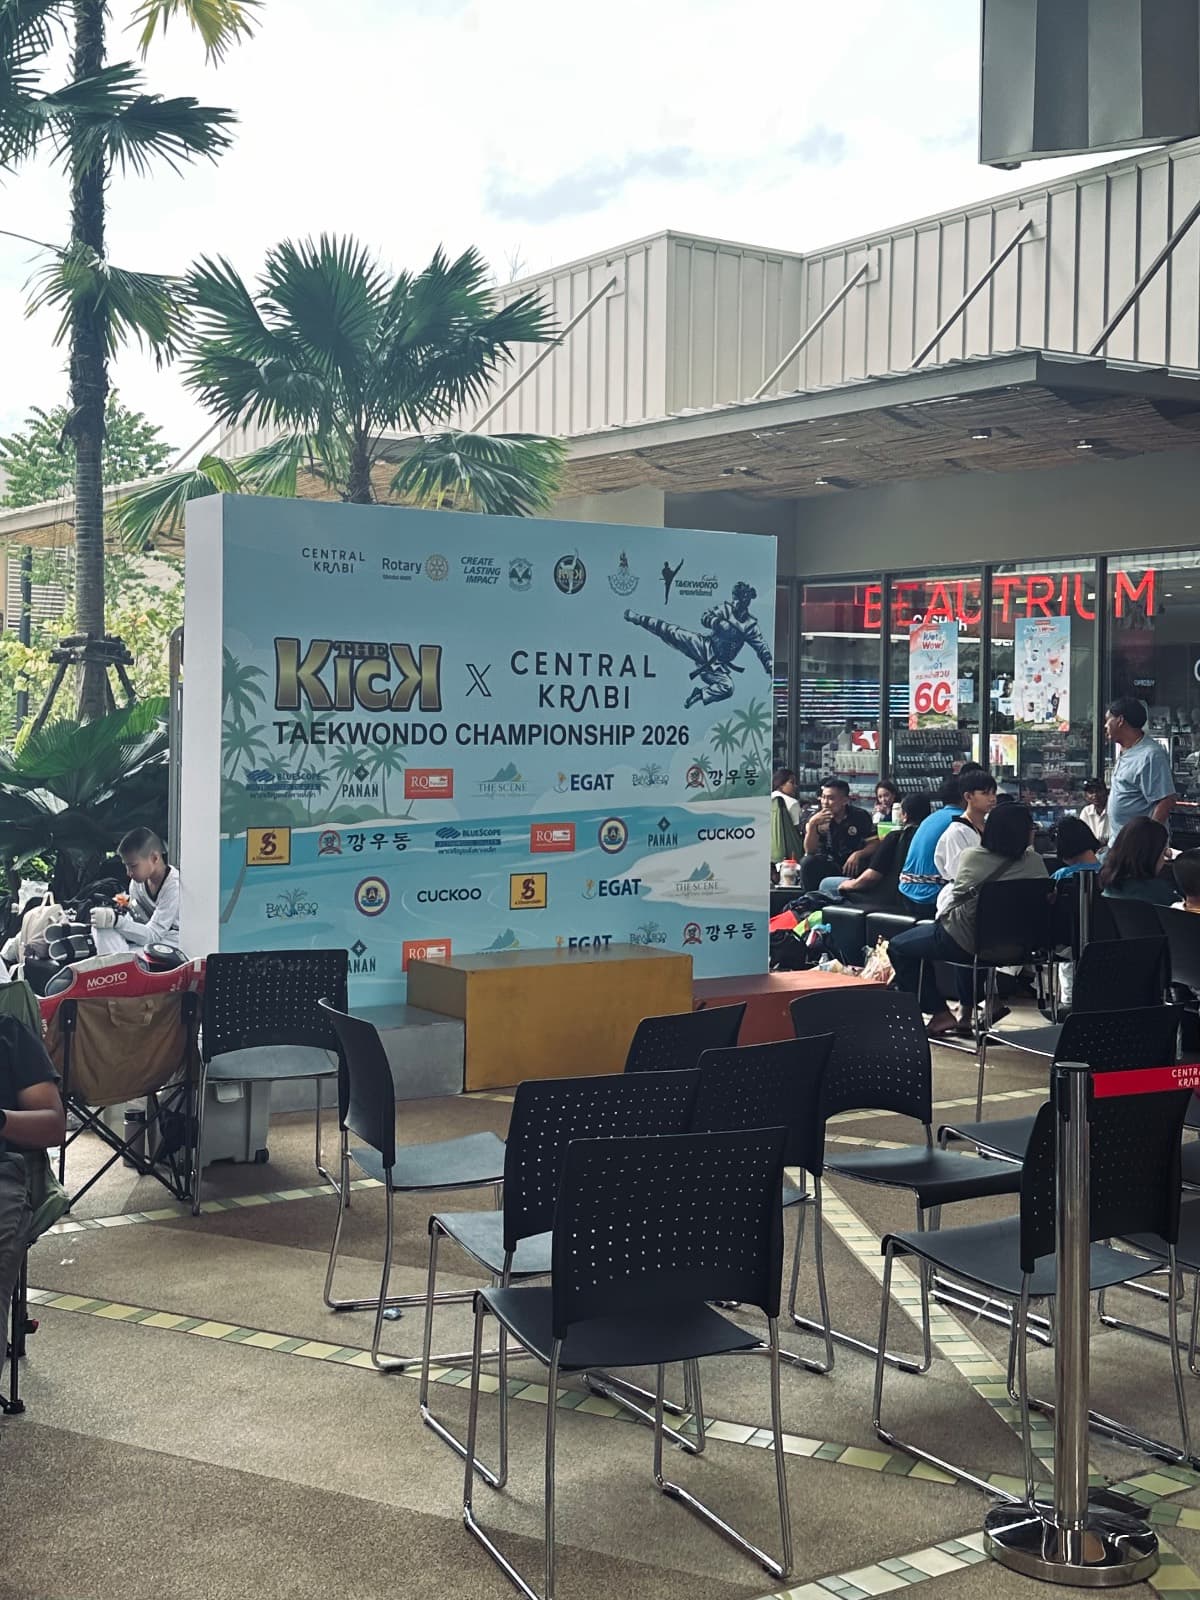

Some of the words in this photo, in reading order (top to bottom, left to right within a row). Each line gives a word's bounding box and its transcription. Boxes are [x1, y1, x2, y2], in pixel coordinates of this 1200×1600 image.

[302, 547, 366, 562] CENTRAL
[460, 556, 495, 566] CREATE
[313, 561, 354, 574] KRABI
[382, 558, 422, 575] Rotary
[463, 566, 501, 576] LASTING
[465, 575, 499, 585] IMPACT
[334, 641, 389, 659] THE
[510, 650, 657, 678] CENTRAL
[538, 684, 630, 713] KRABI
[272, 721, 448, 746] TAEKWONDO
[455, 722, 636, 746] CHAMPIONSHIP
[641, 724, 690, 746] 2026
[411, 776, 429, 789] RQ
[570, 773, 615, 791] EGAT
[708, 769, 760, 786] 깡우동
[342, 783, 379, 798] PANAN
[478, 783, 495, 793] THE
[498, 783, 528, 793] SCENE
[536, 830, 553, 843] RQ
[647, 833, 678, 847] PANAN
[697, 827, 756, 841] CUCKOO
[346, 832, 412, 852] 깡우동
[598, 878, 642, 897] EGAT
[675, 882, 691, 892] THE
[692, 882, 719, 892] SCENE
[416, 887, 482, 903] CUCKOO
[705, 922, 757, 942] 깡우동
[347, 957, 376, 974] ANAN
[86, 971, 128, 988] MOOTO
[1171, 1067, 1200, 1078] CENTR
